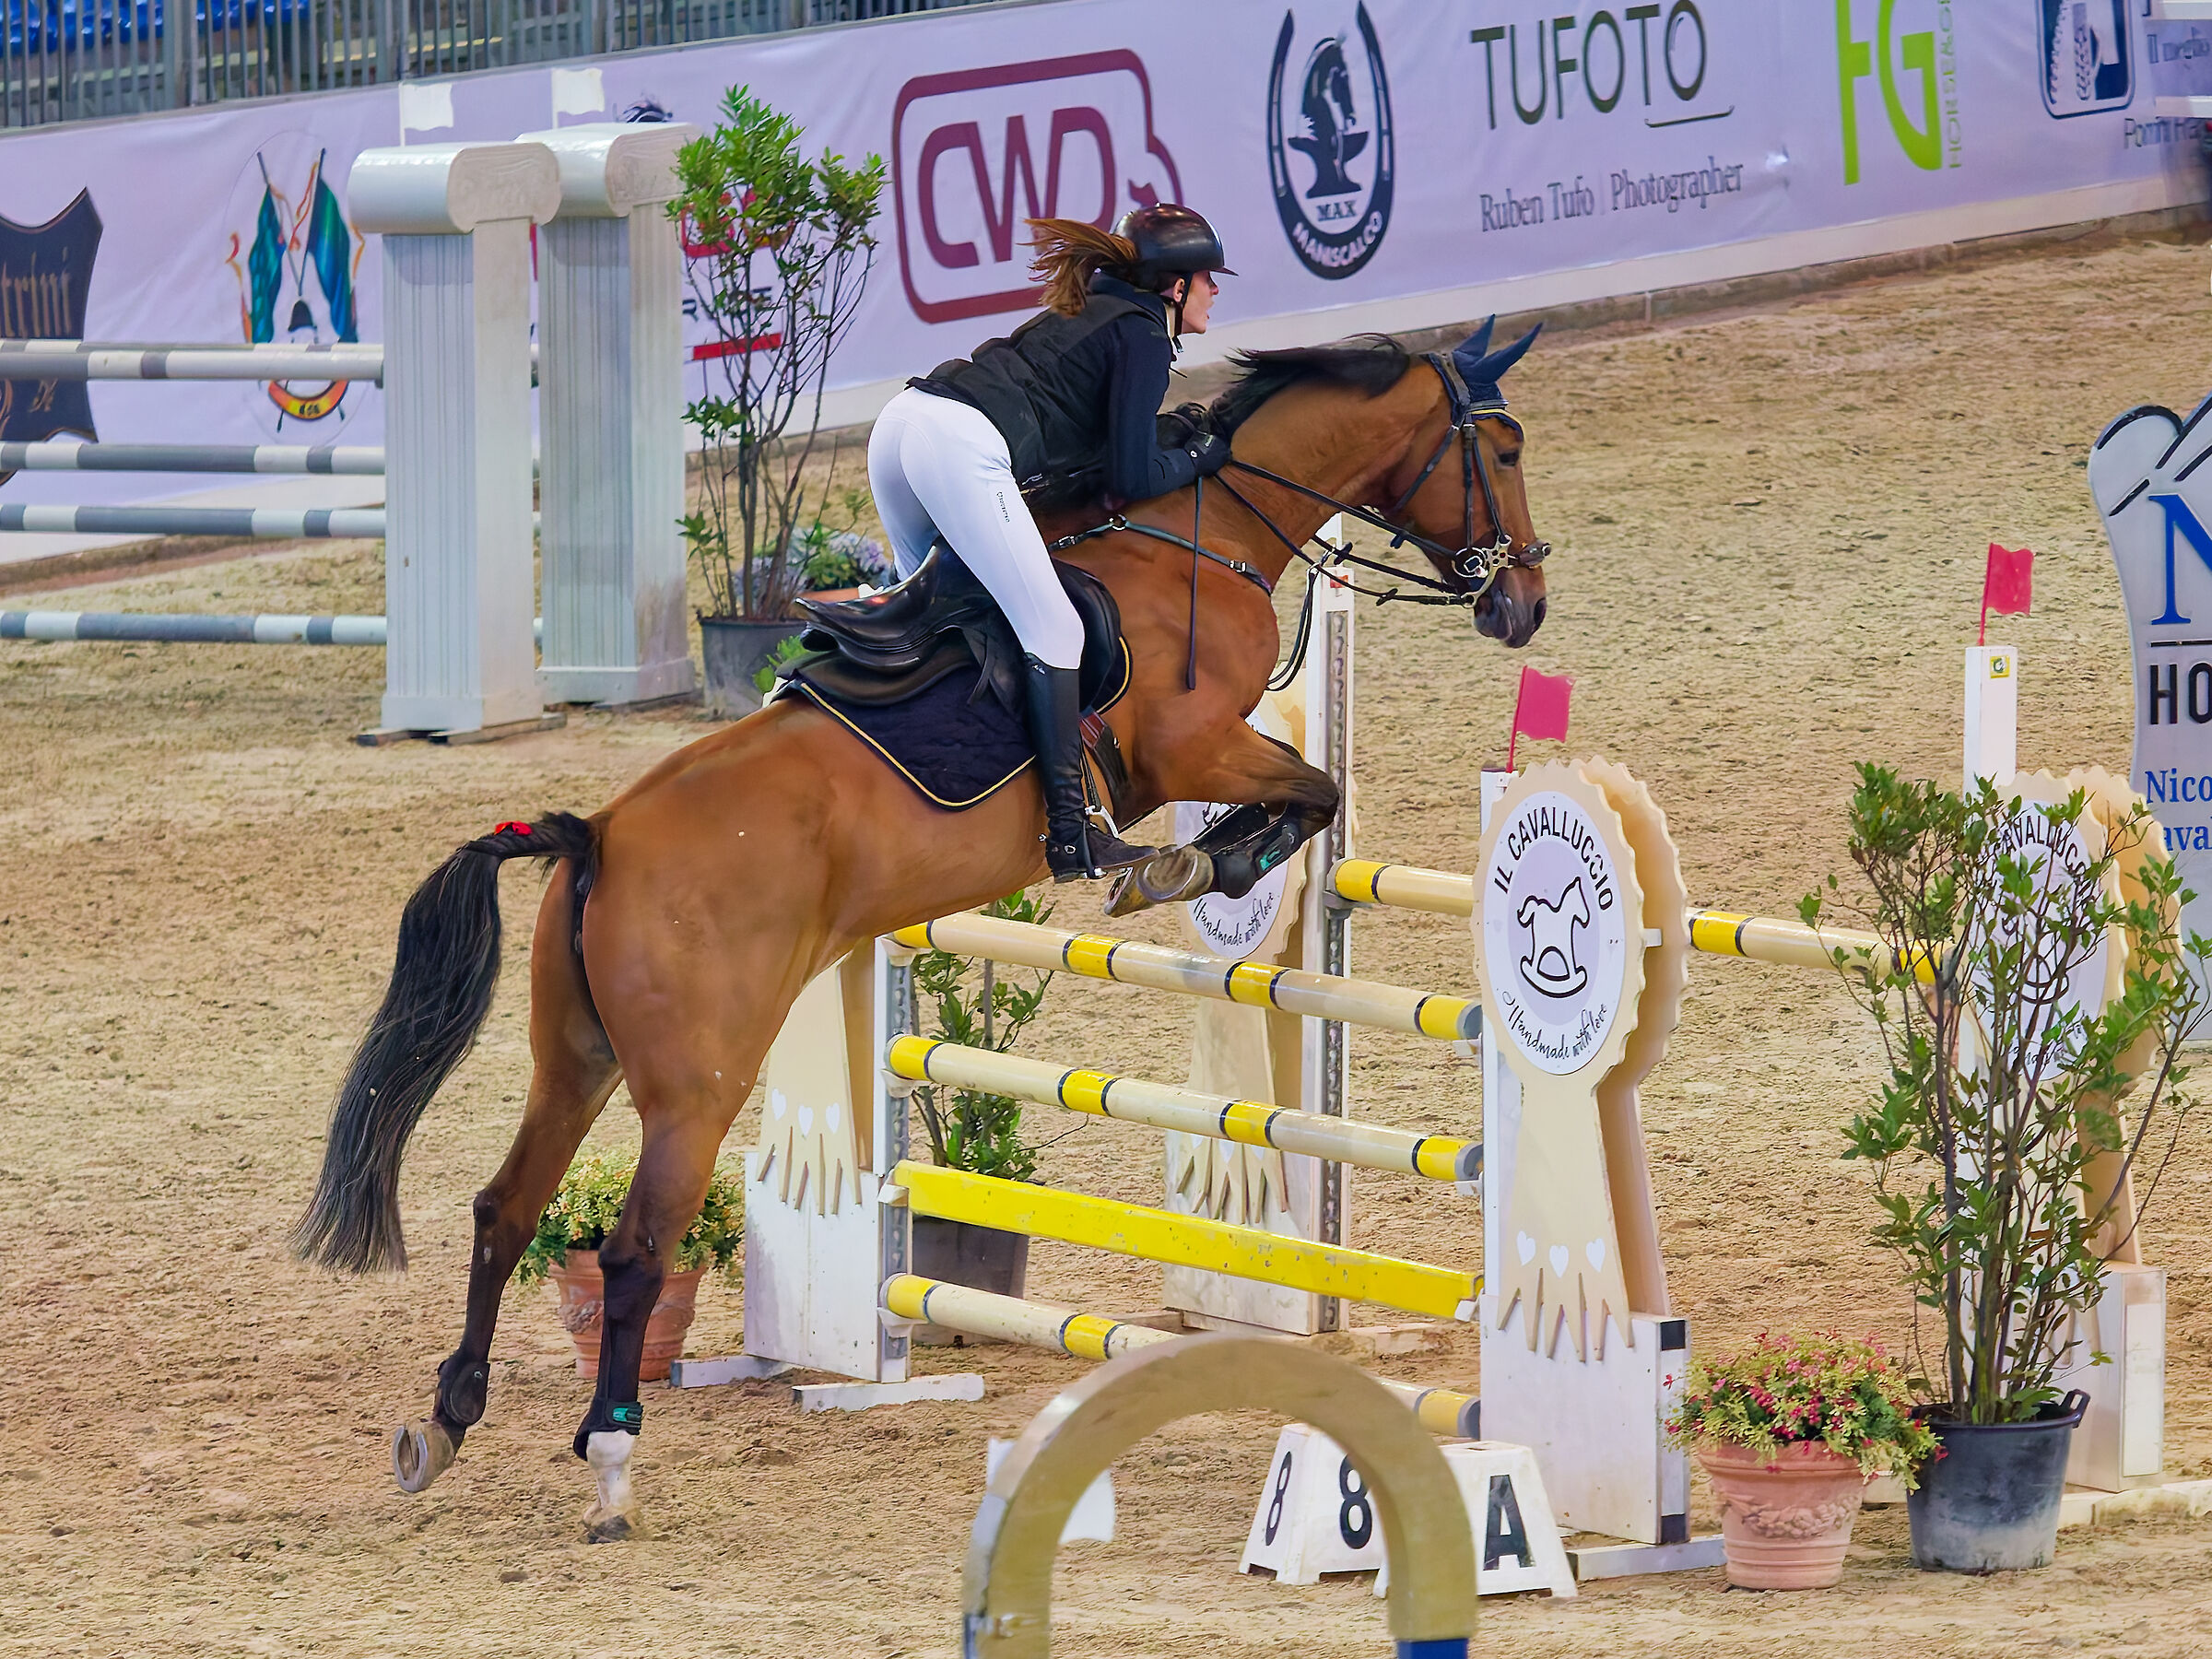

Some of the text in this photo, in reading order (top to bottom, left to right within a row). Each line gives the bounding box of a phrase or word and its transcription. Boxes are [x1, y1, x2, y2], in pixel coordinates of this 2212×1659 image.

[1470, 0, 1707, 130] TUFOTO
[917, 105, 1117, 269] CWD
[1316, 199, 1358, 222] MAX
[1480, 155, 1744, 232] Ruben Tufo Photographer
[2144, 767, 2212, 804] Nico
[1493, 806, 1614, 911] IL CAVALLUCCIO
[1502, 991, 1570, 1060] Handmade
[1265, 1451, 1292, 1547] 8
[1339, 1453, 1373, 1550] 8
[1483, 1474, 1535, 1571] A
